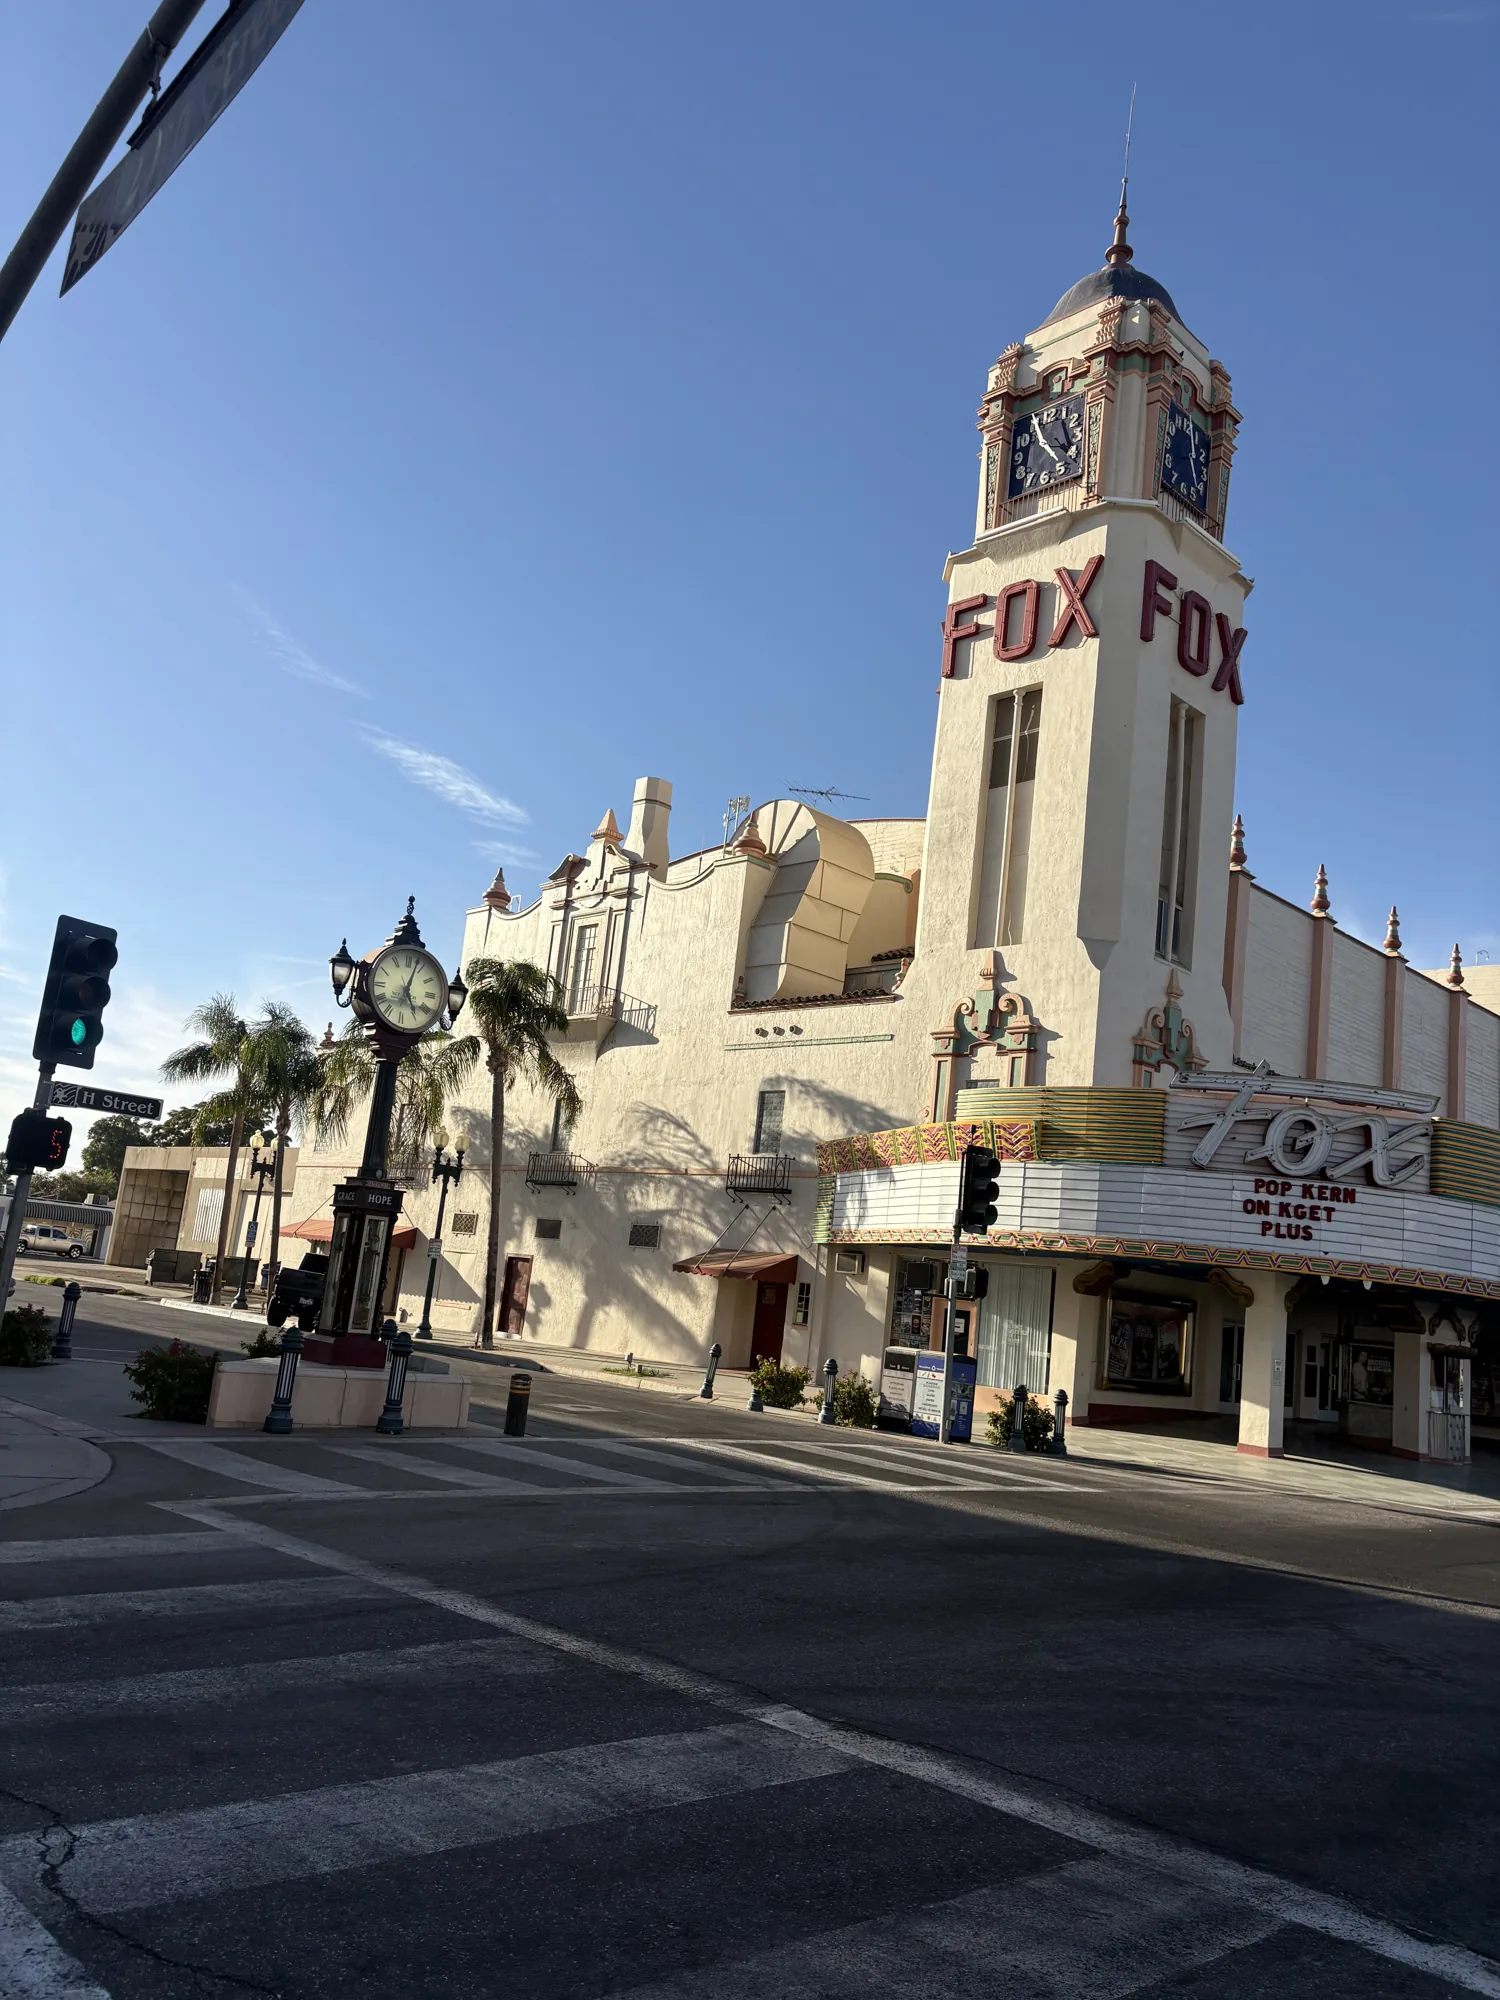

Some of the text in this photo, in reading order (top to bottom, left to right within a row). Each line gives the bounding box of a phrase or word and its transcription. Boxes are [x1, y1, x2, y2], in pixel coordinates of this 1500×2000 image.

[1043, 408, 1057, 424] 12
[1062, 406, 1069, 420] 1
[1069, 413, 1079, 428] 2
[1175, 413, 1182, 430] 11
[1016, 433, 1030, 450] 10
[1073, 427, 1082, 442] 3
[1195, 431, 1199, 445] 1
[1014, 451, 1023, 465] 9
[1066, 445, 1078, 459] 4
[1200, 448, 1206, 464] 2
[1055, 461, 1065, 475] 5
[1165, 453, 1172, 469] 8
[1015, 465, 1026, 480] 8
[1025, 472, 1035, 488] 7
[1039, 470, 1050, 485] 6
[1171, 470, 1178, 484] 7
[1201, 466, 1207, 482] 3
[1180, 481, 1187, 496] 6
[1189, 486, 1197, 502] 5
[941, 554, 1105, 679] FOX
[1140, 558, 1248, 705] FOX
[82, 1091, 154, 1115] H Street
[368, 1193, 393, 1205] HOPE
[1254, 1178, 1356, 1204] POP KERN
[1242, 1198, 1336, 1223] ON KGET
[1261, 1220, 1313, 1241] PLUS
